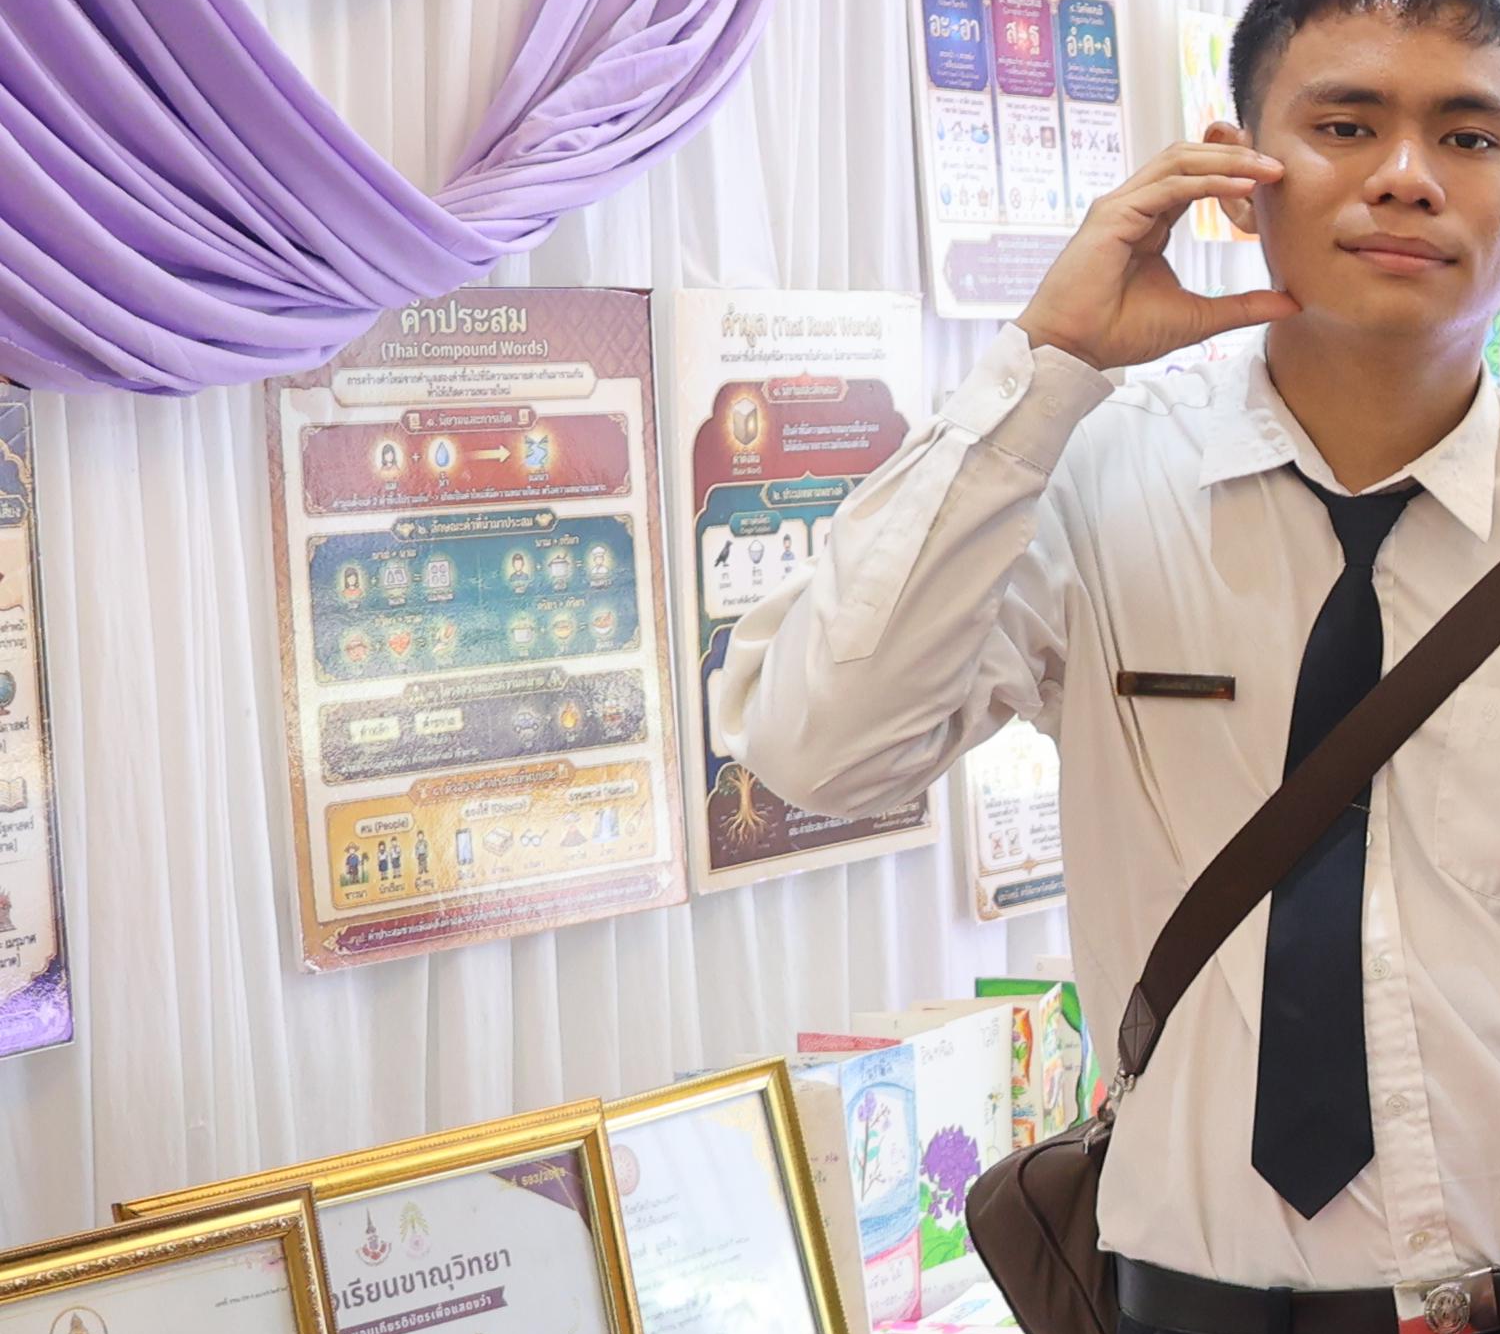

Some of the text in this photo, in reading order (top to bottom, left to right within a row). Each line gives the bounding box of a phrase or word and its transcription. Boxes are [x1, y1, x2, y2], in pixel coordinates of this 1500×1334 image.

[381, 339, 549, 361] (Thai Compound Words)
